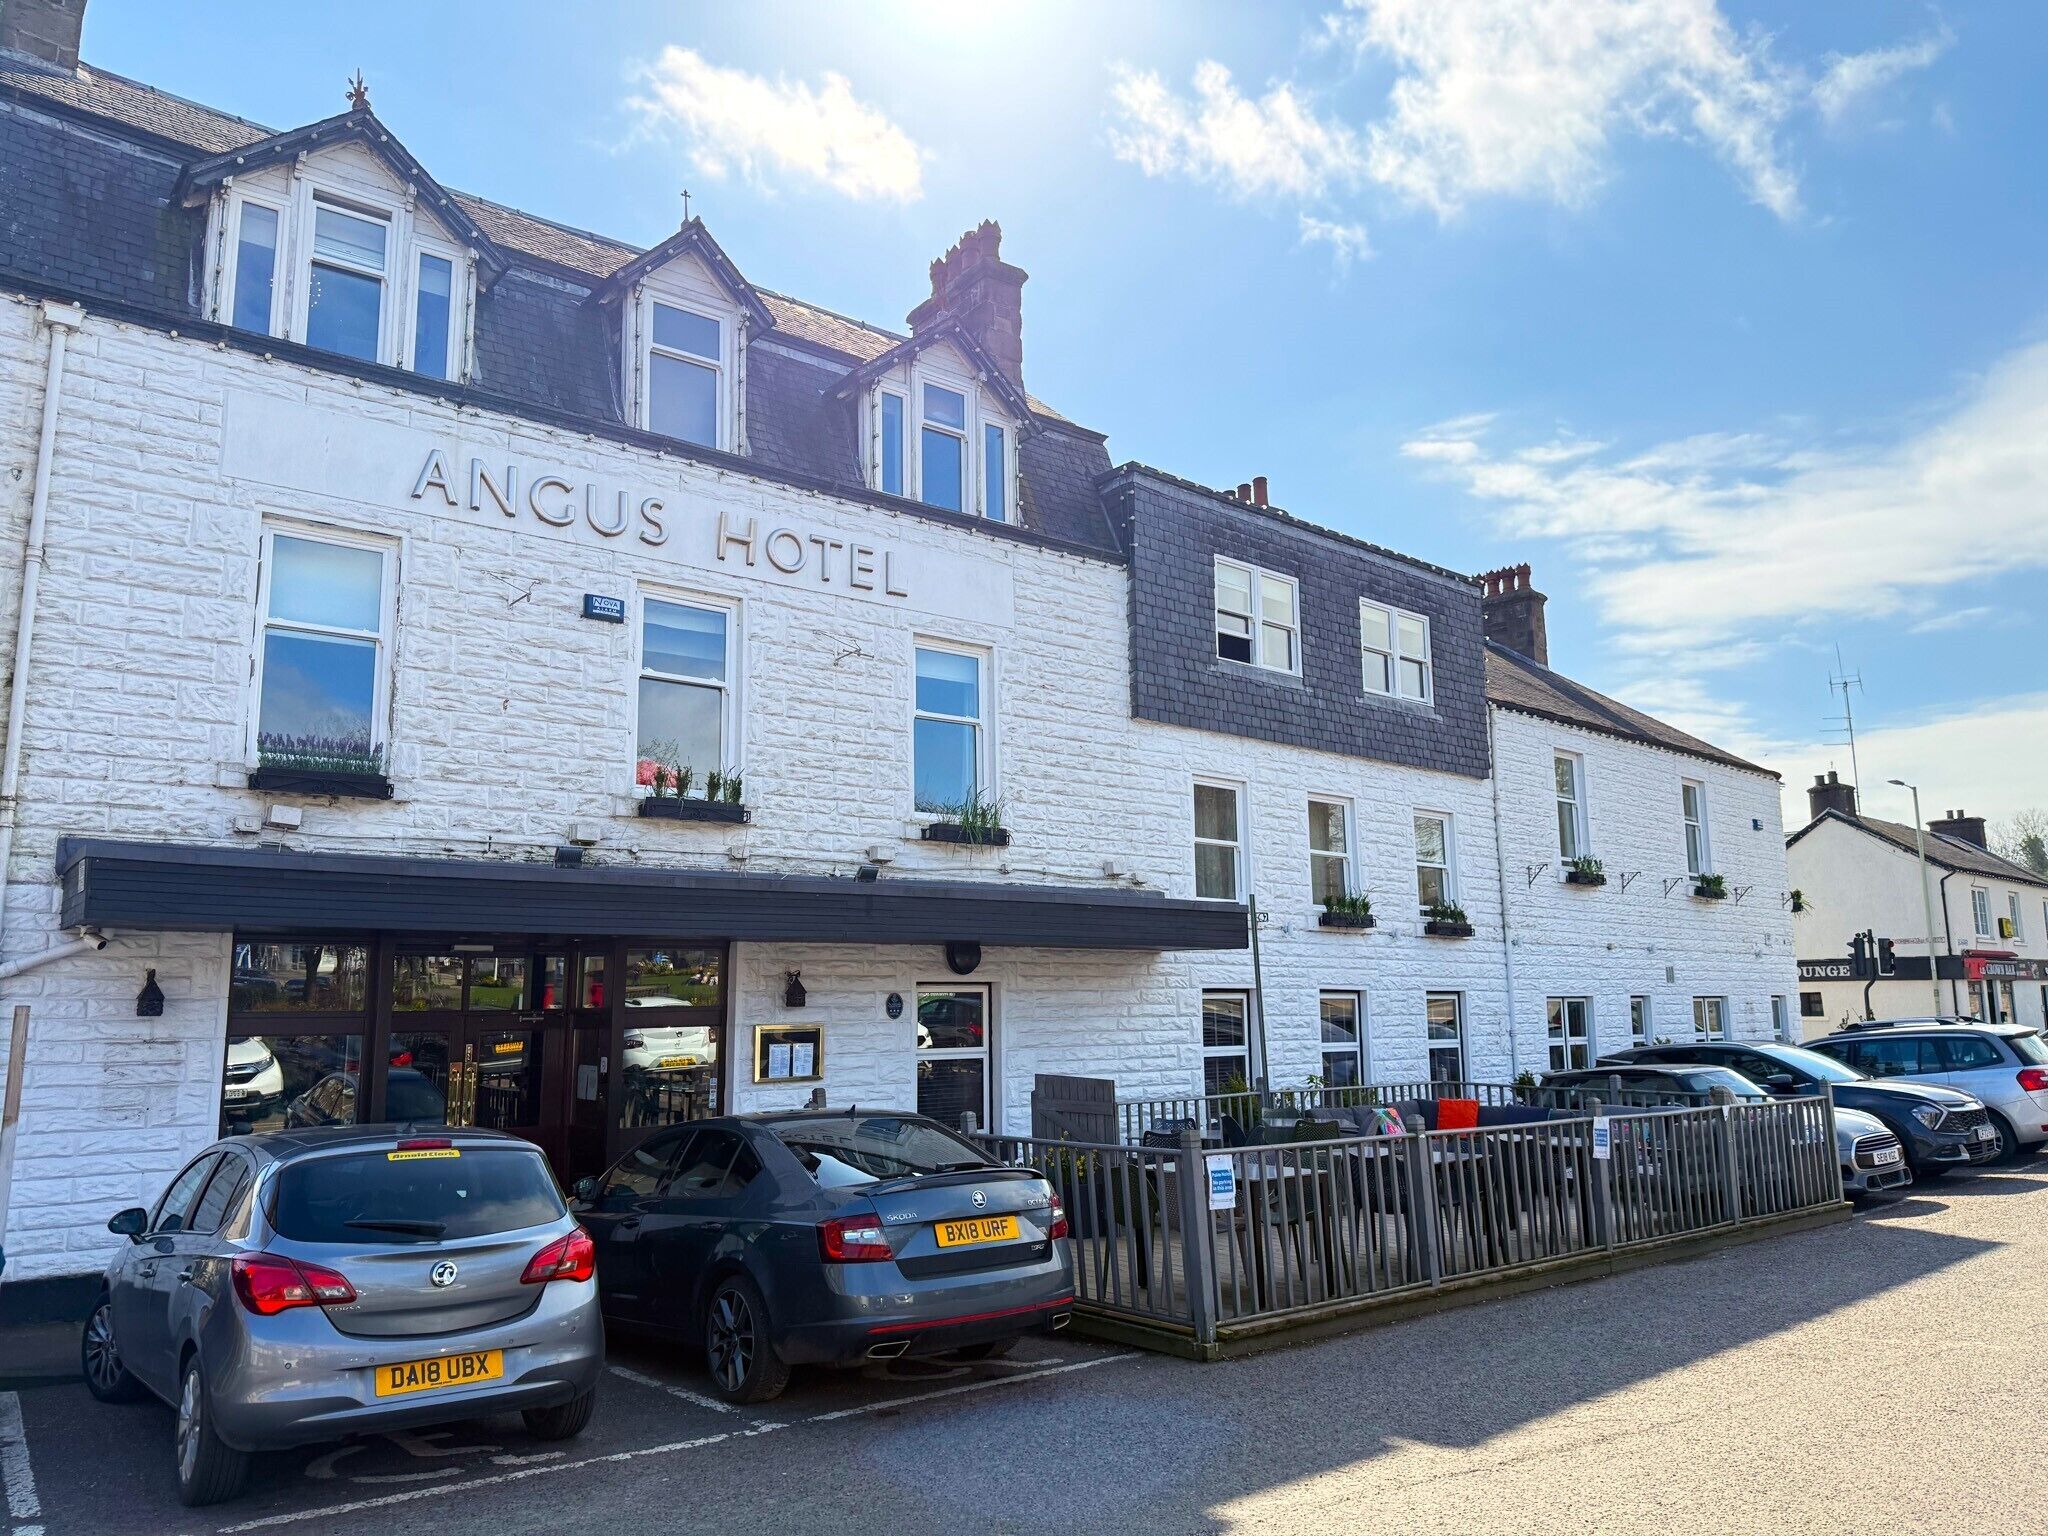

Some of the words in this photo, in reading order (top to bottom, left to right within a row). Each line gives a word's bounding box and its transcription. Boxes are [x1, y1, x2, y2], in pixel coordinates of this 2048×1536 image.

[411, 448, 670, 546] ANGUS
[717, 511, 908, 598] HOTEL
[594, 598, 618, 608] NOVA
[945, 1221, 979, 1242] BX18
[982, 1219, 1008, 1237] URF
[390, 1361, 441, 1389] DA18
[446, 1353, 489, 1380] UBX
